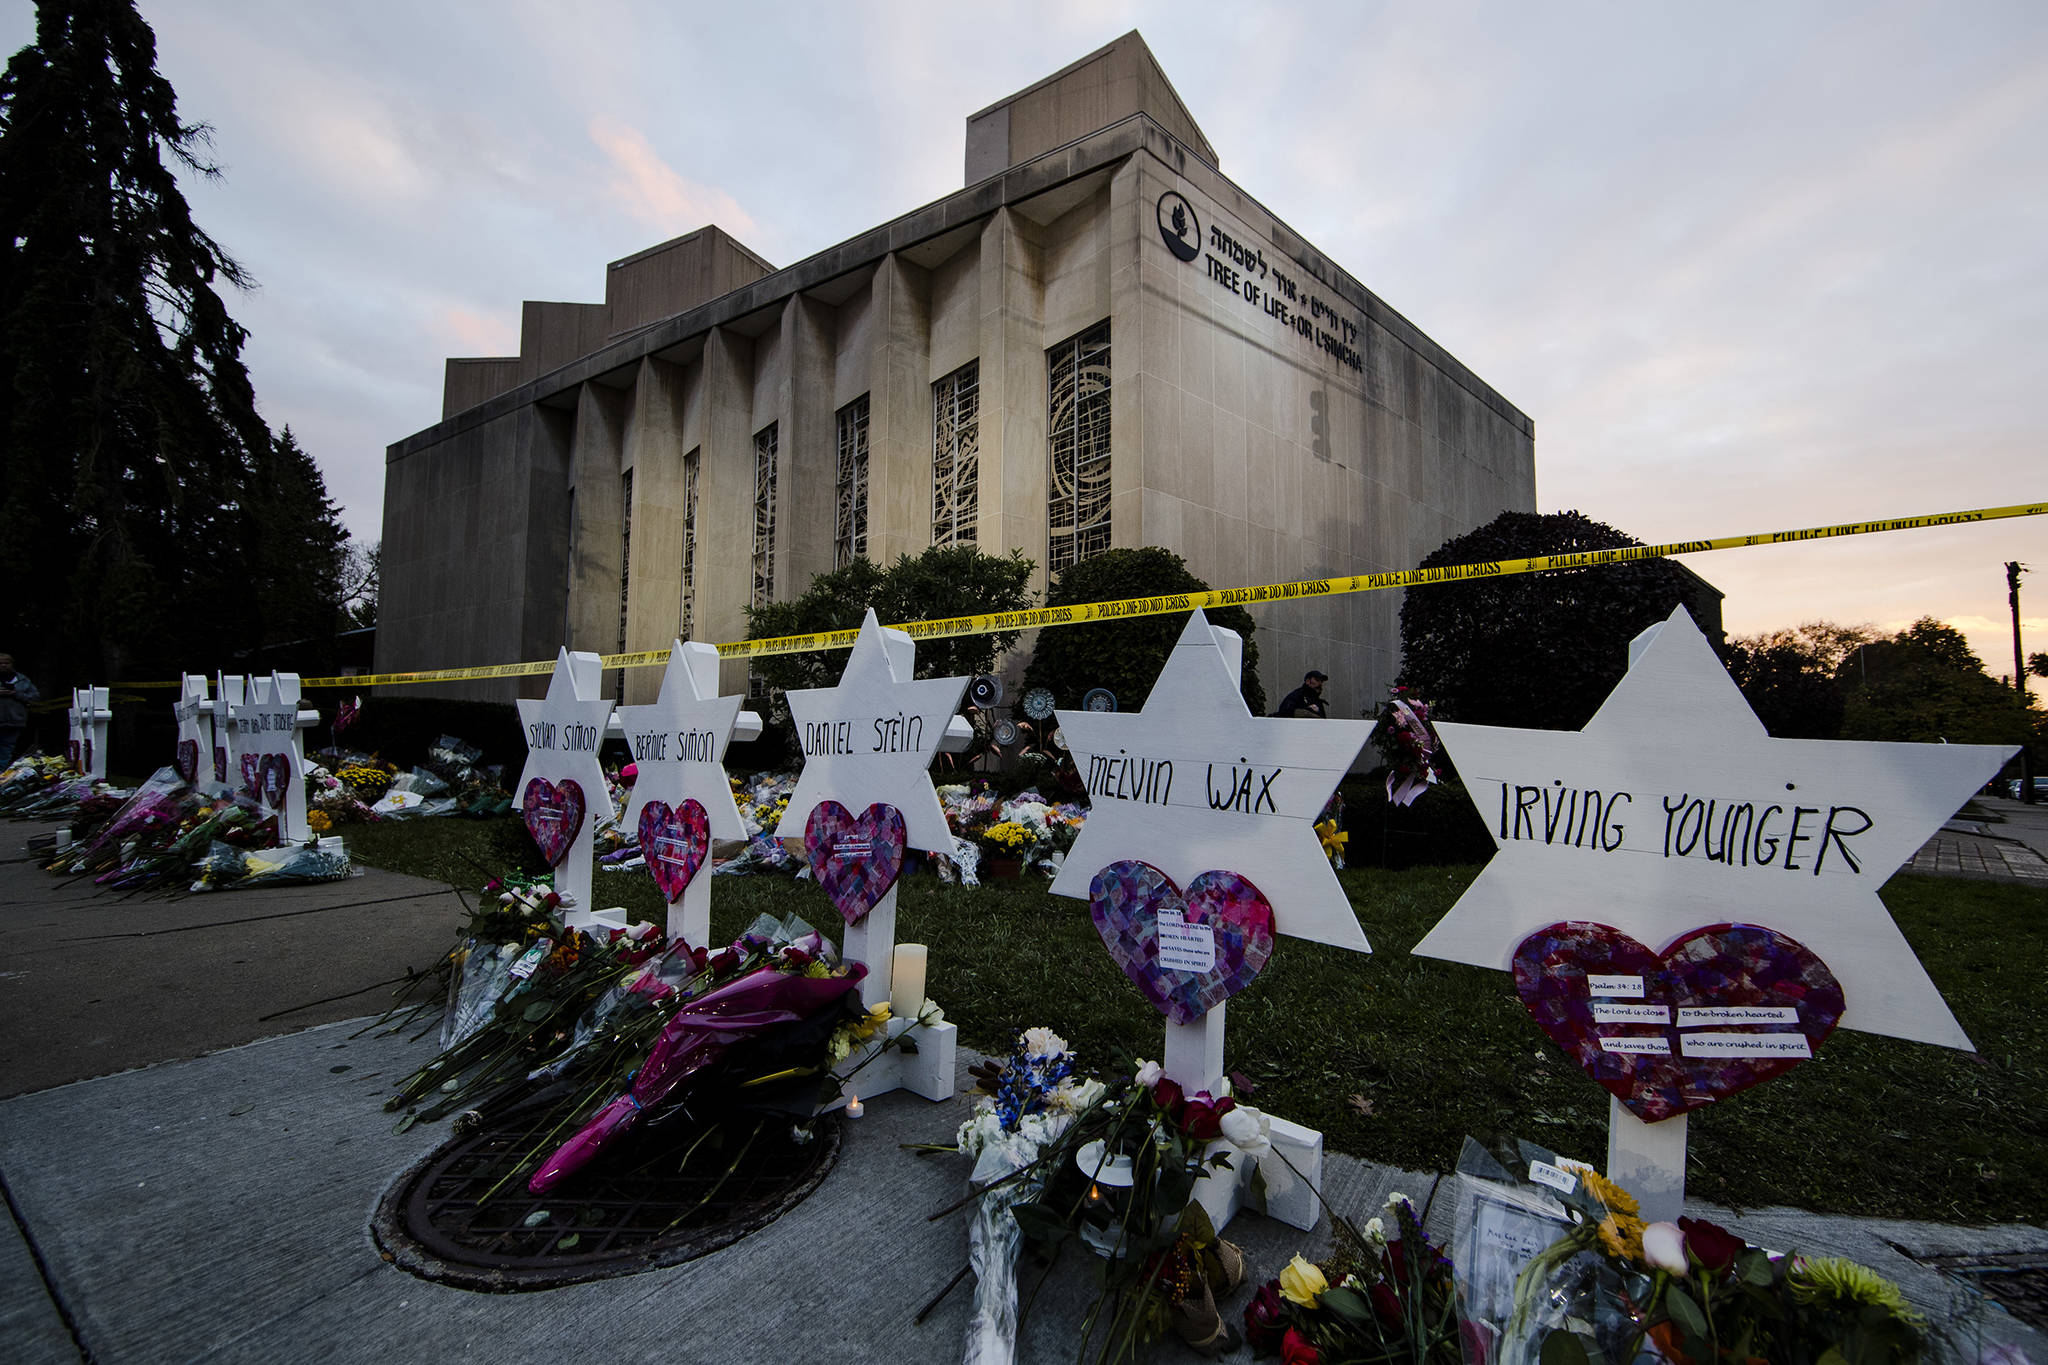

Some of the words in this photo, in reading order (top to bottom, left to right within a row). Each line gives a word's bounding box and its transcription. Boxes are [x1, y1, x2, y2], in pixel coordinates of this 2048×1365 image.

[1211, 225, 1268, 279] לשמחה
[1205, 253, 1240, 295] TREE
[1244, 280, 1261, 306] OF
[1263, 292, 1289, 326] LIFE
[1297, 315, 1313, 342] OR
[1272, 268, 1297, 302] אור
[1311, 296, 1339, 331] חיים
[1548, 553, 1587, 568] POLICE
[1591, 550, 1616, 564] LINE
[1670, 540, 1712, 554] CROSS
[1368, 572, 1400, 588] POLICE
[1402, 570, 1424, 584] LINE
[1427, 568, 1441, 582] DO
[1443, 566, 1464, 580] NOT
[1466, 561, 1500, 577] CROSS
[1098, 602, 1121, 618] POLICE
[1121, 600, 1138, 615] LINE
[1138, 599, 1149, 614] DO
[1150, 598, 1164, 612] NOT
[1165, 595, 1190, 610] CROSS
[1220, 588, 1248, 604] POLICE
[1249, 586, 1268, 601] LINE
[1269, 584, 1281, 599] DO
[1282, 583, 1298, 598] NOT
[1301, 580, 1330, 596] CROSS
[906, 624, 923, 638] POLICE
[924, 622, 935, 636] LINE
[936, 622, 944, 635] DO
[944, 620, 954, 634] NOT
[955, 619, 973, 633] CROSS
[995, 614, 1014, 629] POLICE
[1015, 612, 1027, 627] LINE
[1028, 612, 1038, 626] DO
[1039, 610, 1050, 624] NOT
[1052, 608, 1072, 623] CROSS
[529, 723, 557, 751] SYLVAN
[562, 723, 598, 752] SIMON
[636, 732, 668, 762] BERNICE
[676, 730, 715, 763] SIMON
[806, 720, 854, 757] DANIEL
[872, 714, 923, 754] STEIN
[1087, 753, 1174, 806] MELVIN
[1206, 762, 1283, 814] WAX
[1500, 782, 1632, 852] IRVING
[1662, 792, 1875, 876] YOUNGER
[1710, 1010, 1745, 1018] broken
[1745, 1010, 1785, 1019] hearted
[1725, 1041, 1763, 1050] crushed
